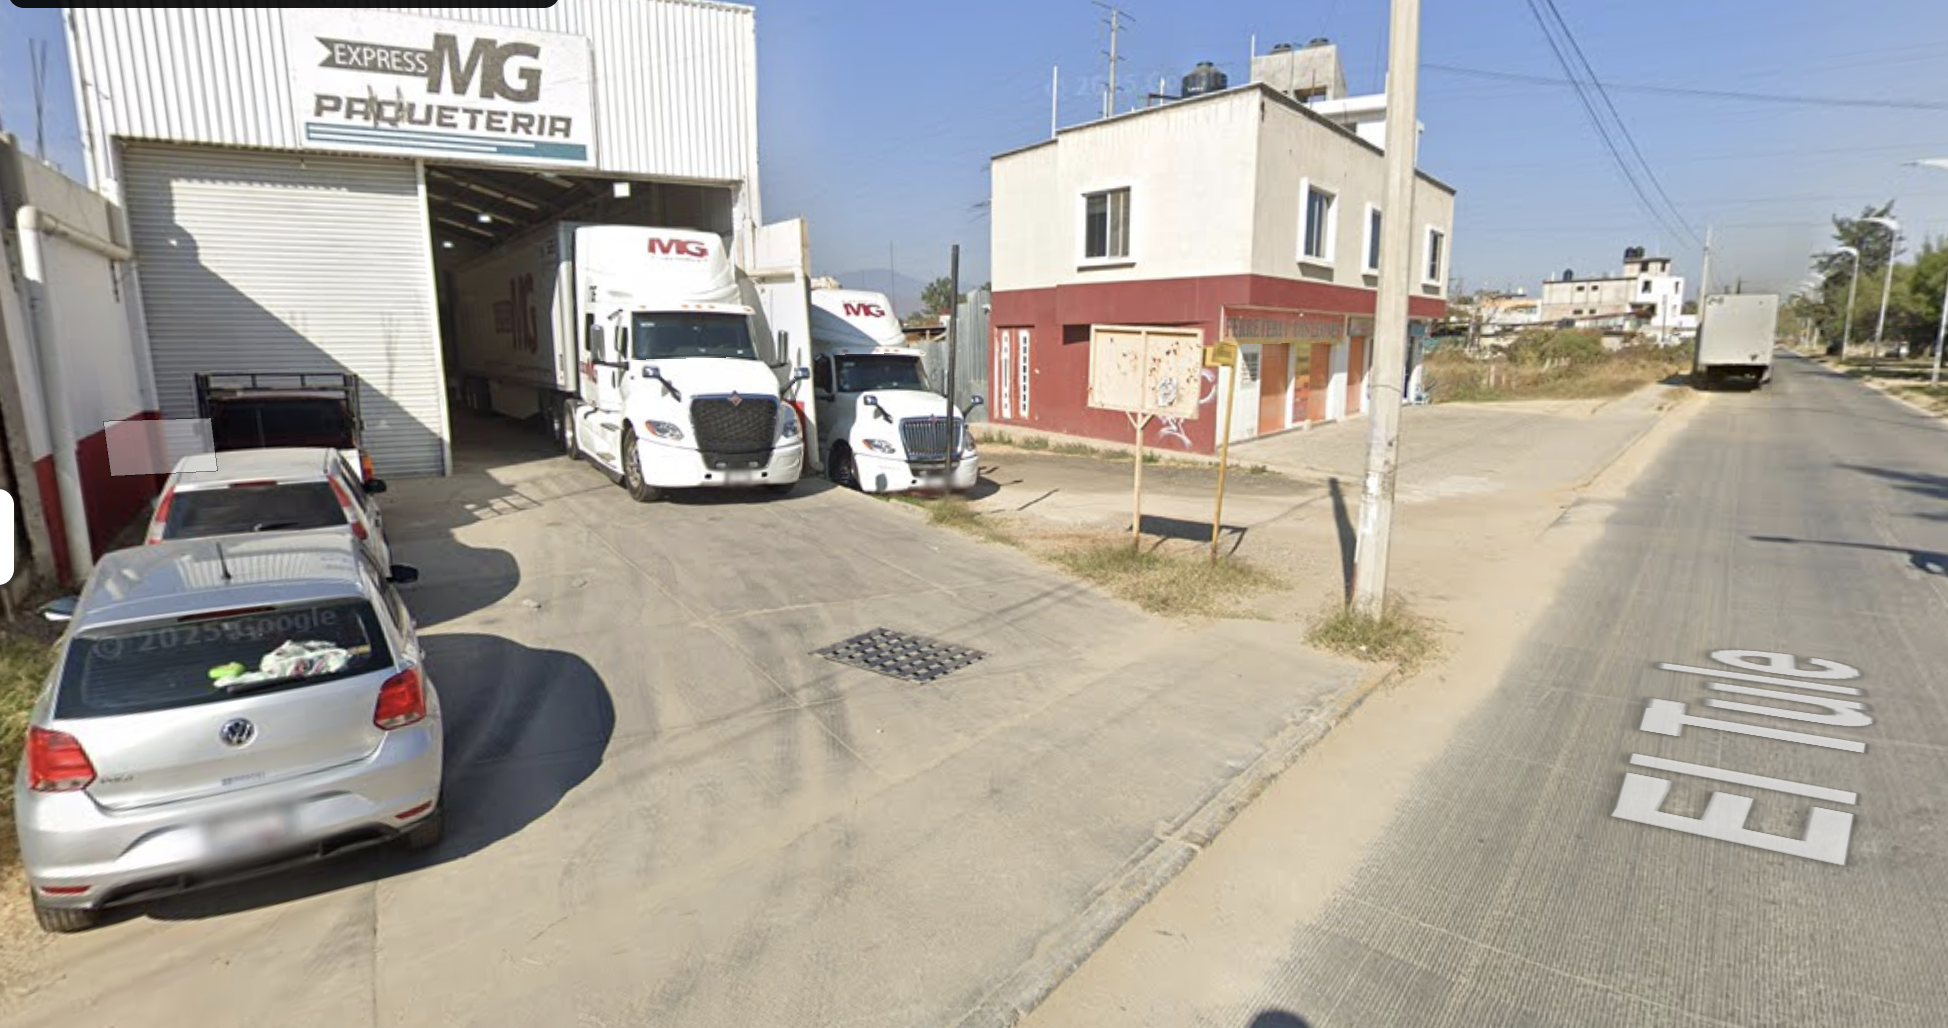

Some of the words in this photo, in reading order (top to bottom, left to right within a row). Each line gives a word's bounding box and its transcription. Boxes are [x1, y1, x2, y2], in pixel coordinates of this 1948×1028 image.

[332, 42, 429, 74] EXPRESS
[426, 32, 543, 103] MG
[313, 93, 573, 139] PAQUETERIA
[647, 237, 709, 258] MG
[843, 302, 886, 318] MG
